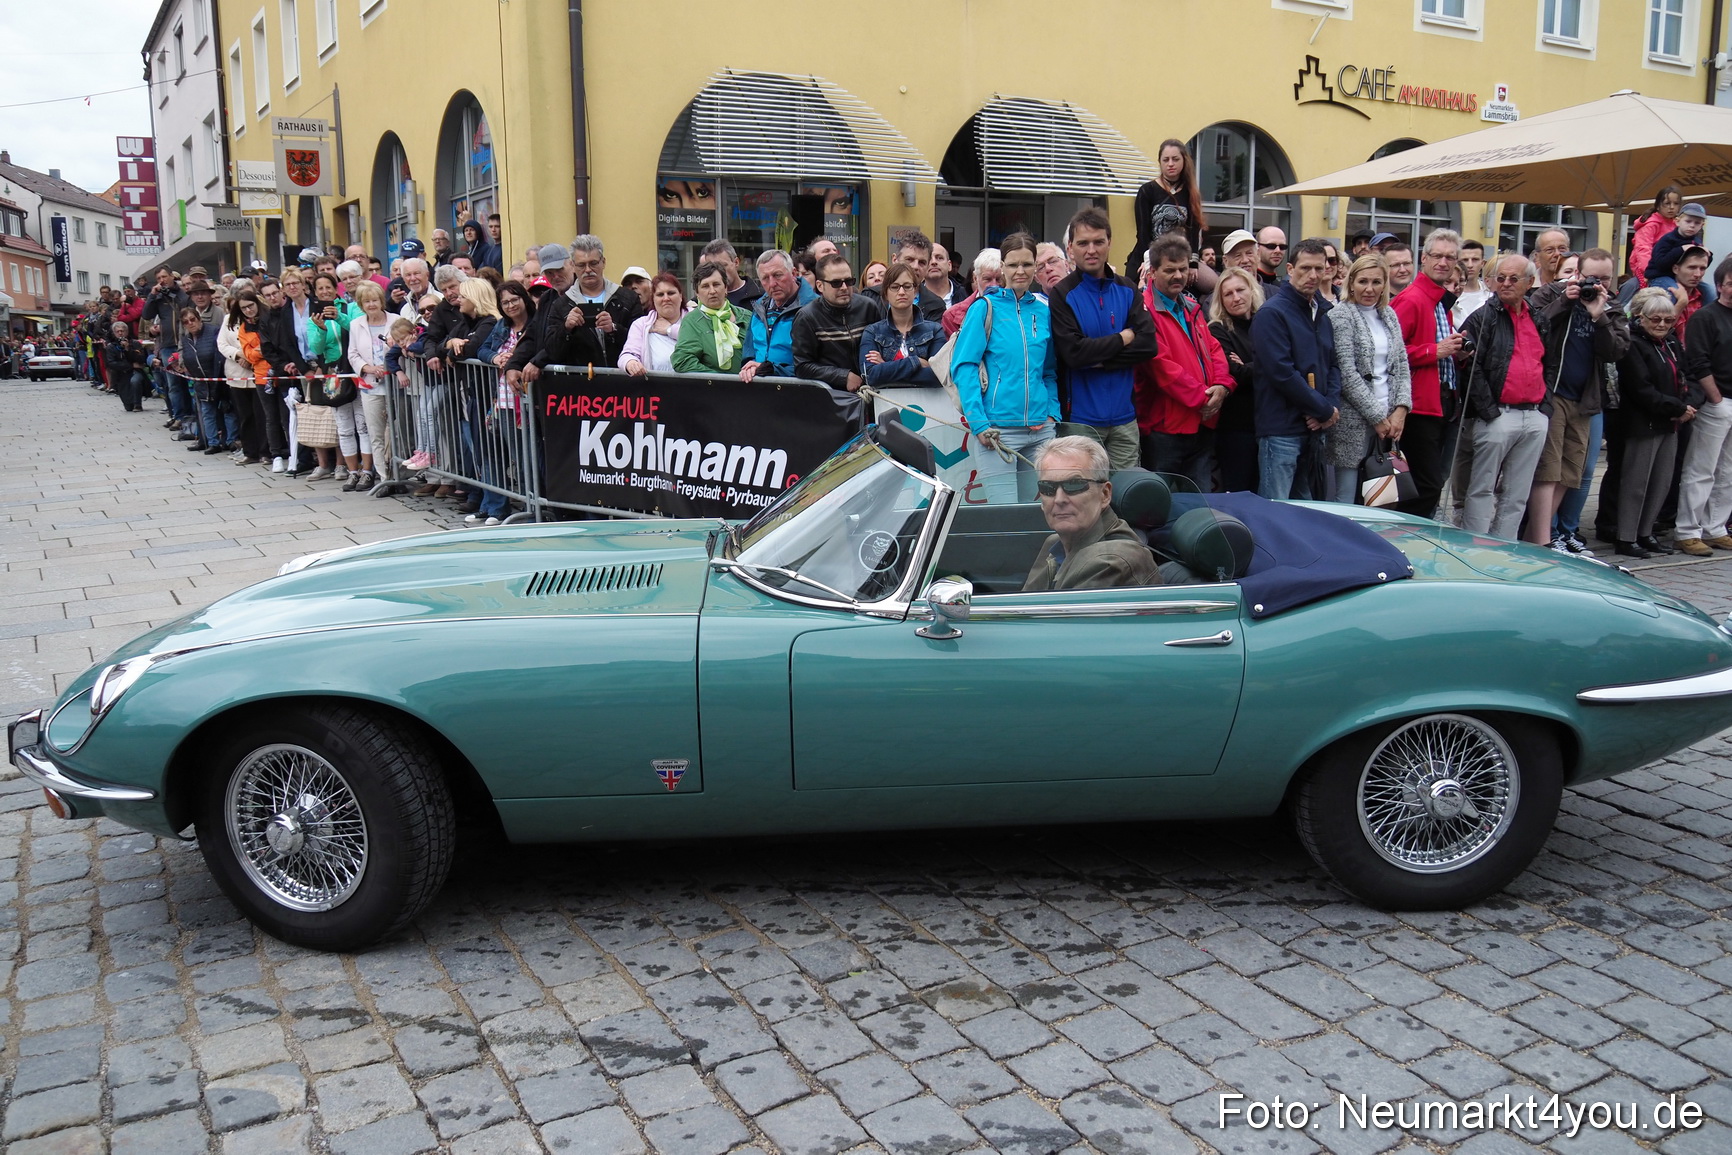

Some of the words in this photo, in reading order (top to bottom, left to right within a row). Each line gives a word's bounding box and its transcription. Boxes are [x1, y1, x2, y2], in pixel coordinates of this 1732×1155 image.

[1338, 65, 1396, 102] CAFÉ
[1398, 84, 1421, 104] AM
[1424, 87, 1478, 113] RATHAUS
[1489, 103, 1514, 112] Neumarkter
[1484, 110, 1518, 121] Lammsbräu
[277, 122, 317, 132] RATHAUS
[318, 124, 324, 133] II
[216, 217, 243, 227] SARAH
[244, 218, 250, 227] K
[658, 214, 685, 223] Digitale
[686, 214, 708, 223] Bilder
[824, 220, 847, 228] sbilder
[125, 235, 159, 246] WITT
[546, 394, 661, 420] FAHRSCHULE
[578, 420, 788, 489] Kohlmann
[579, 468, 625, 486] Neumarkt
[630, 472, 674, 492] Burgthann
[676, 479, 721, 500] Freystadt
